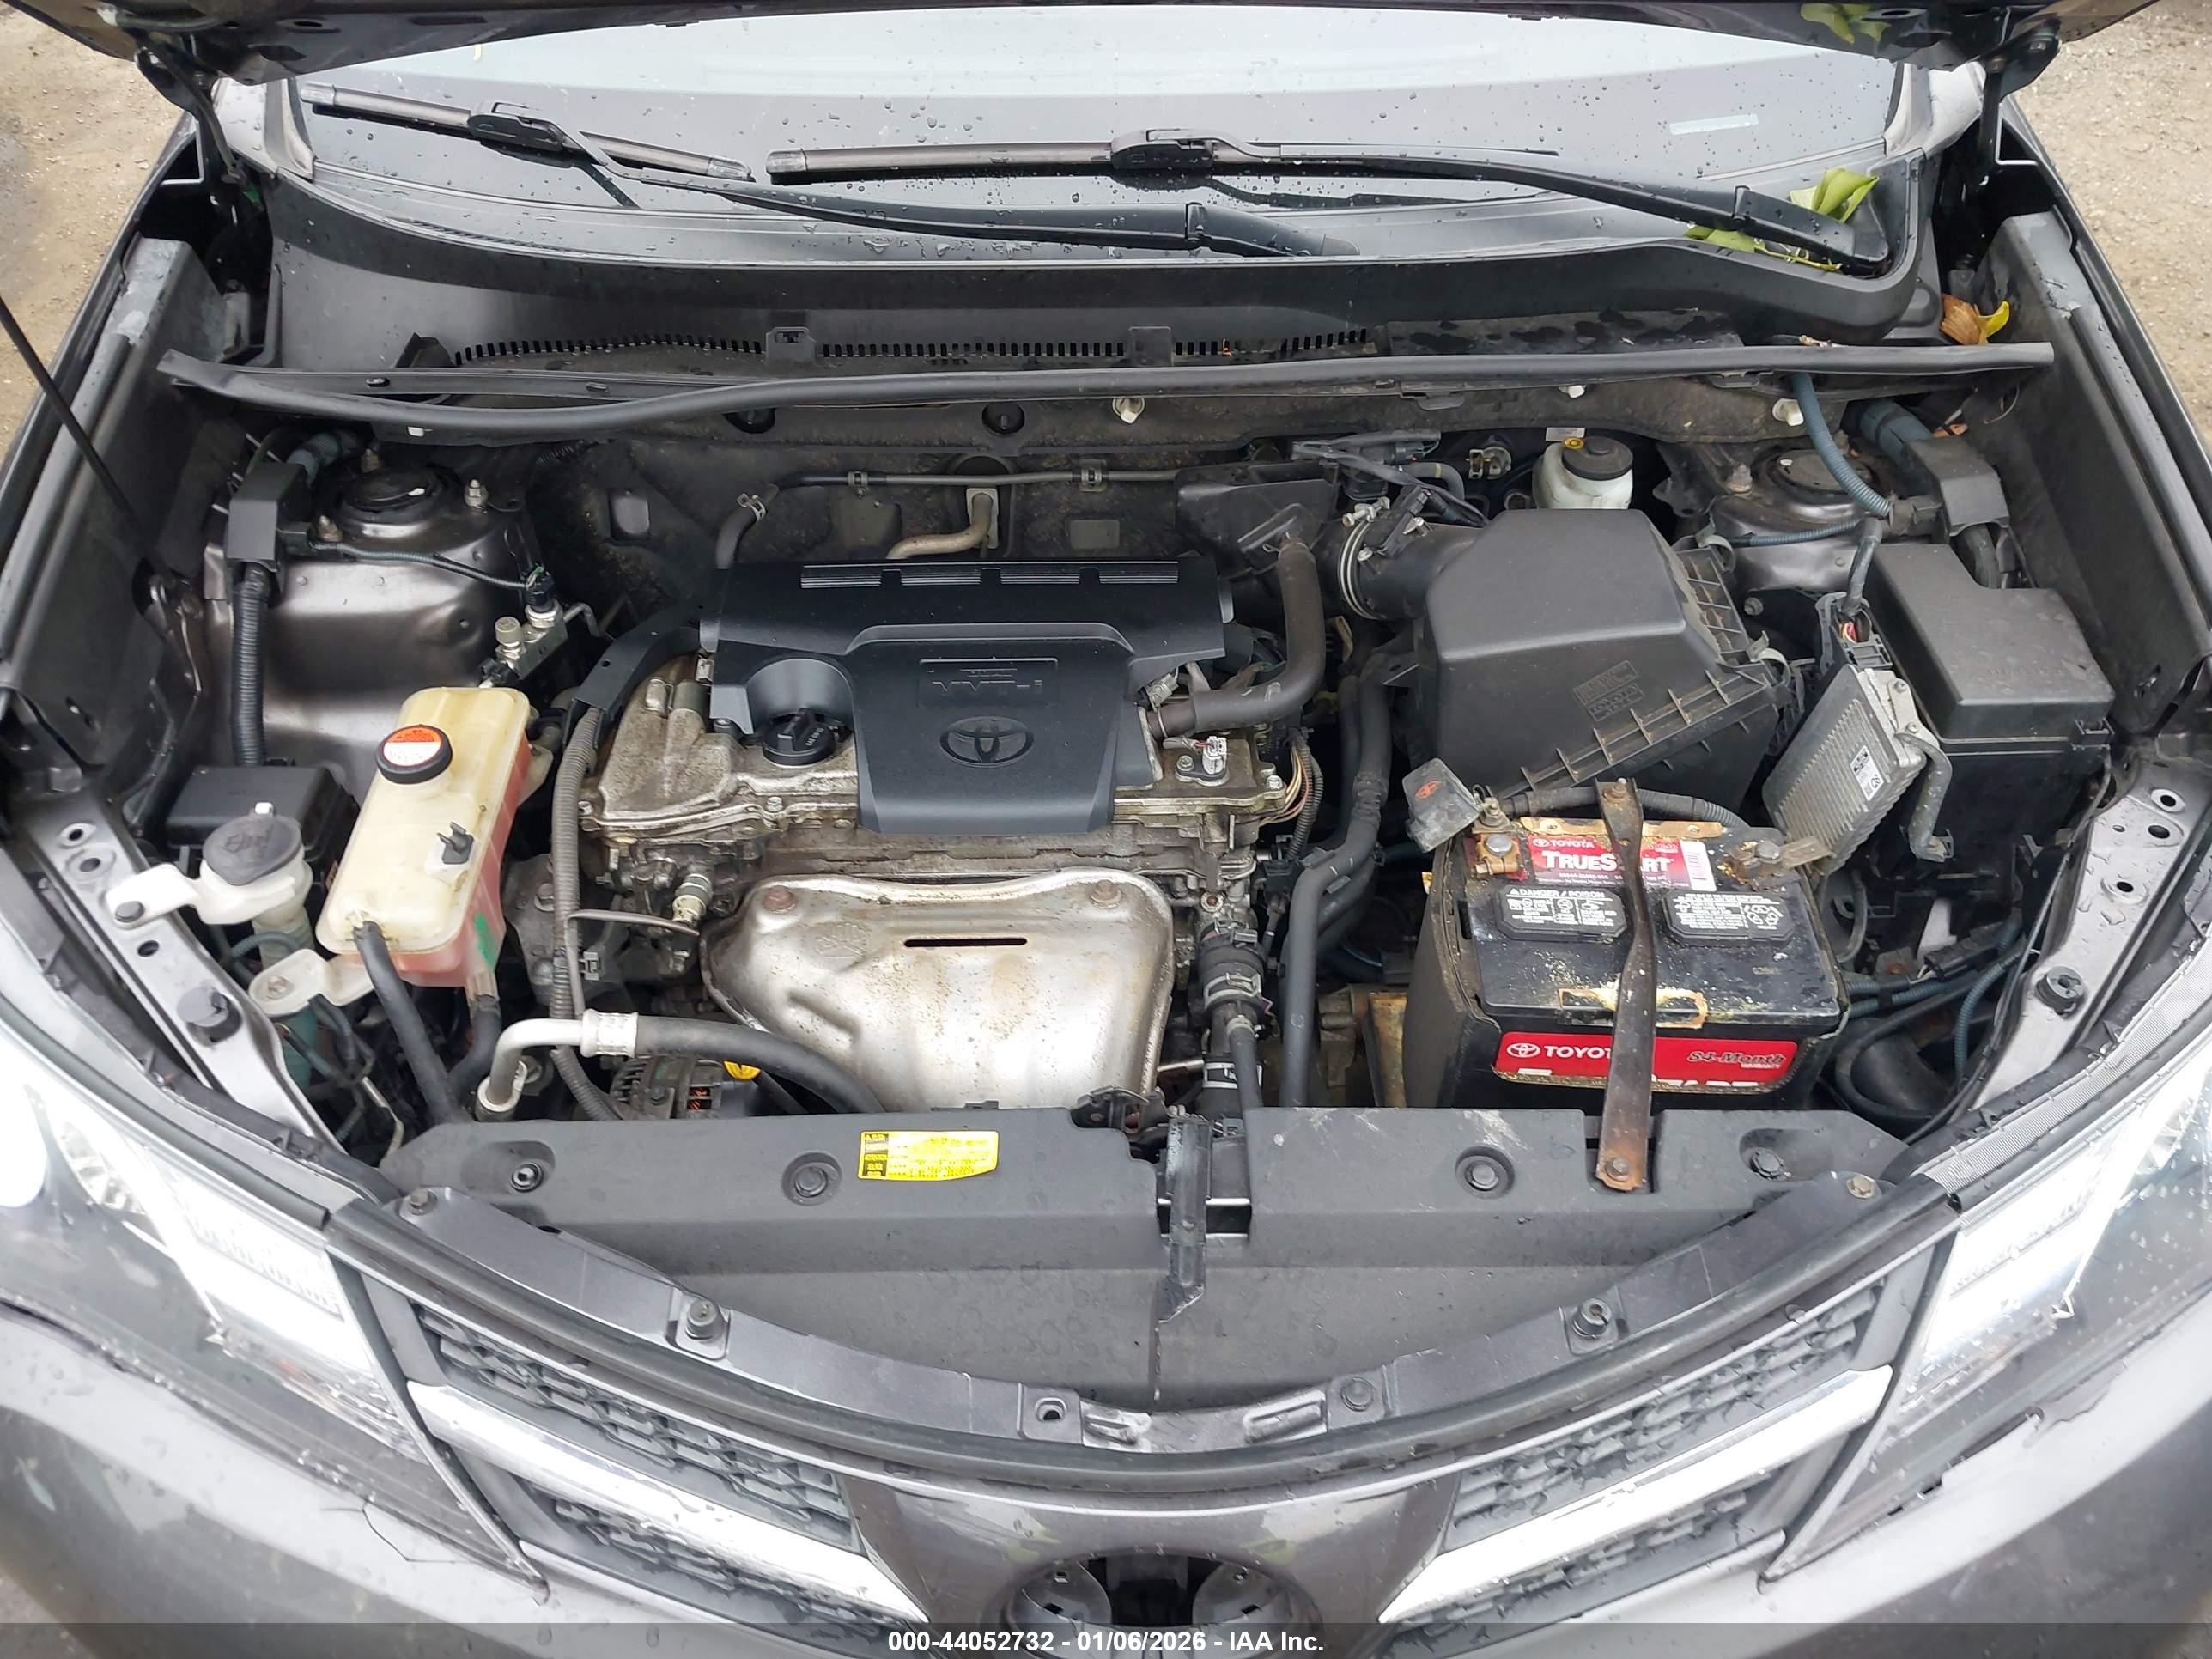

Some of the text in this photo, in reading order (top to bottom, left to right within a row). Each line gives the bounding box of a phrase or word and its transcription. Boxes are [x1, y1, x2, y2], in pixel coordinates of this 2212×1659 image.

[1550, 839, 1595, 848] TOYOTA
[1542, 850, 1672, 872] TRUESRT
[1544, 1045, 1612, 1059] TOYOT
